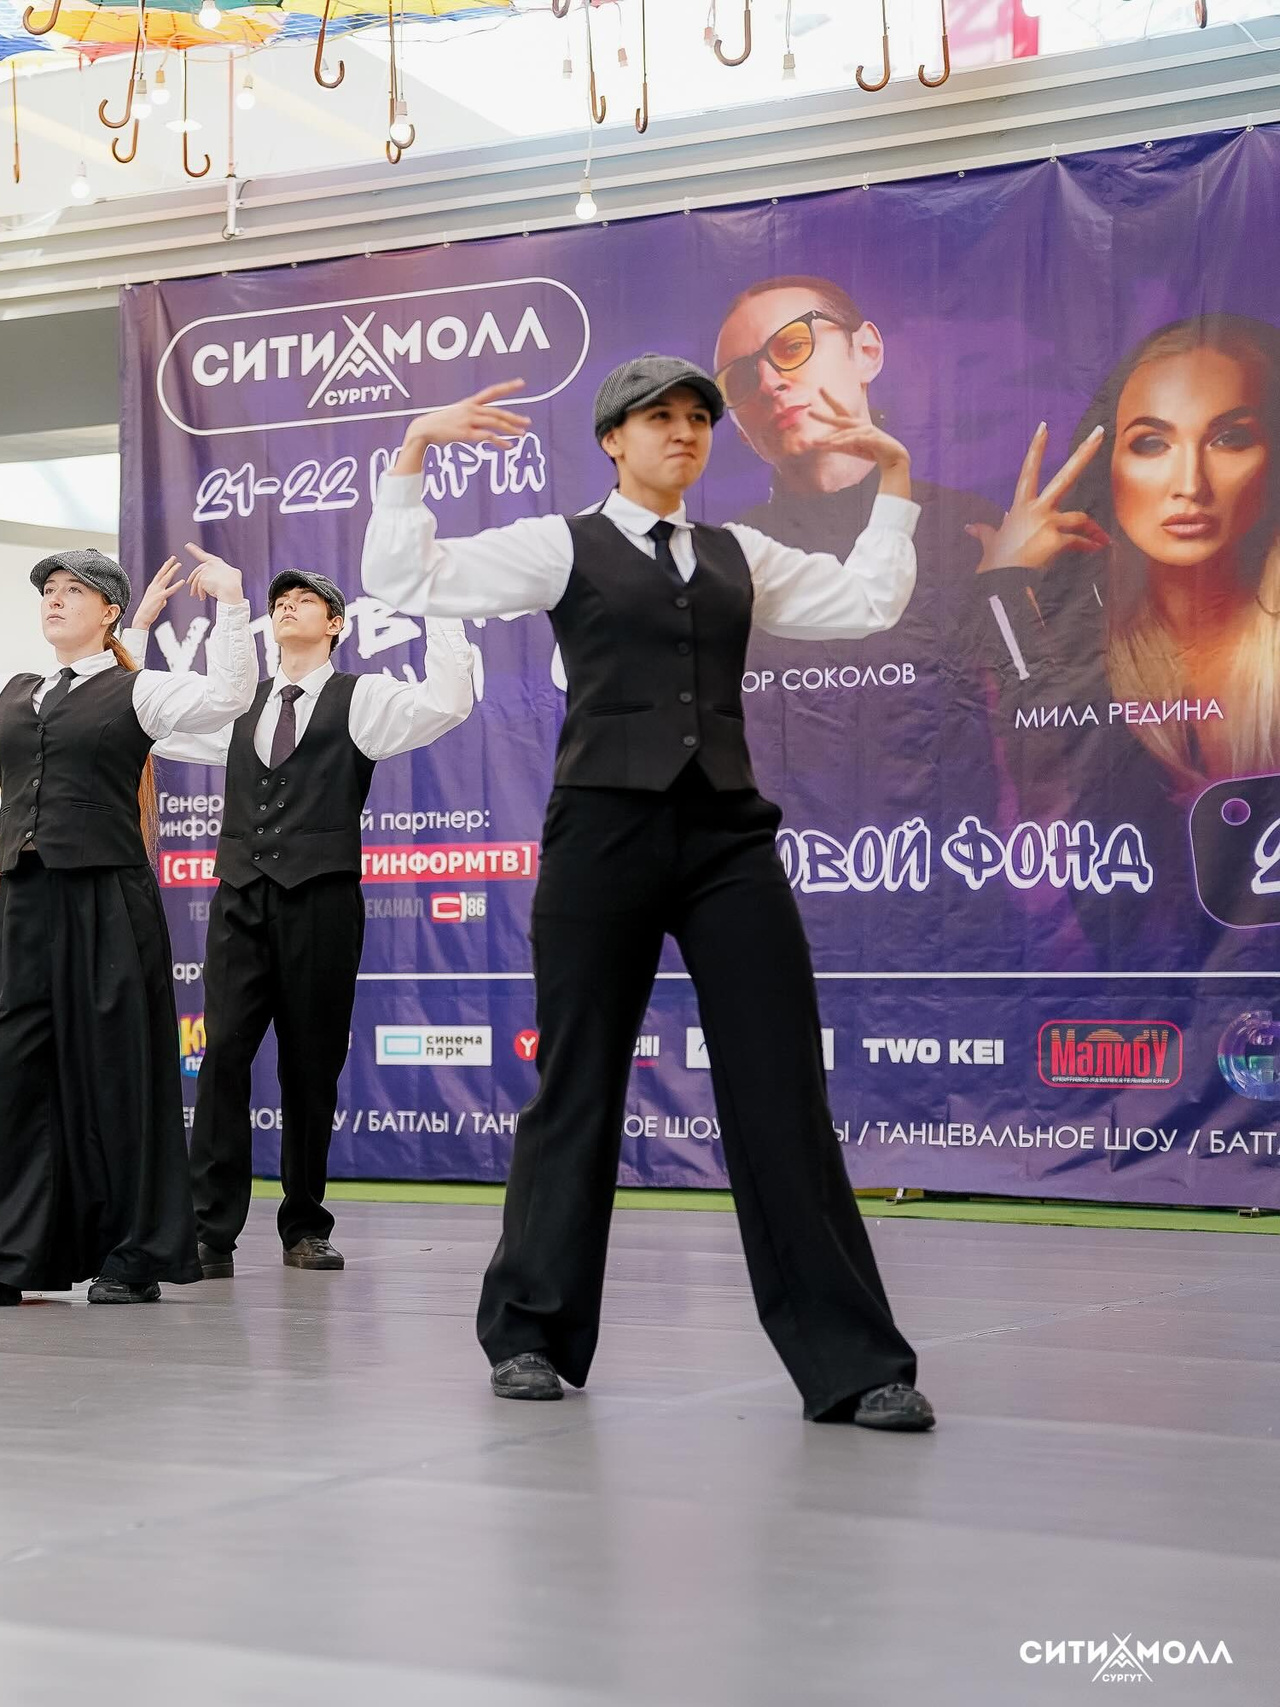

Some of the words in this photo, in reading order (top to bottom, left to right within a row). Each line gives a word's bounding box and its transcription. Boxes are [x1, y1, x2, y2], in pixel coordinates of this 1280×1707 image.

[192, 330, 335, 387] СИТИ
[383, 306, 550, 365] МОЛЛ
[324, 384, 392, 406] СУРГУТ
[193, 456, 359, 522] 21-22
[782, 662, 917, 691] СОКОЛОВ
[1015, 703, 1099, 729] МИЛА
[1109, 698, 1224, 726] РЕДИНА
[380, 809, 490, 835] партнер:
[941, 815, 1153, 895] ФОНД
[862, 1037, 941, 1065] TWO
[949, 1038, 1005, 1065] KEI
[368, 1109, 450, 1134] БАТТЛЫ
[877, 1121, 1094, 1149] ТАНЦЕВАЛЬНОЕ
[1104, 1126, 1178, 1153] ШОУ
[1209, 1130, 1280, 1156] БАТТ
